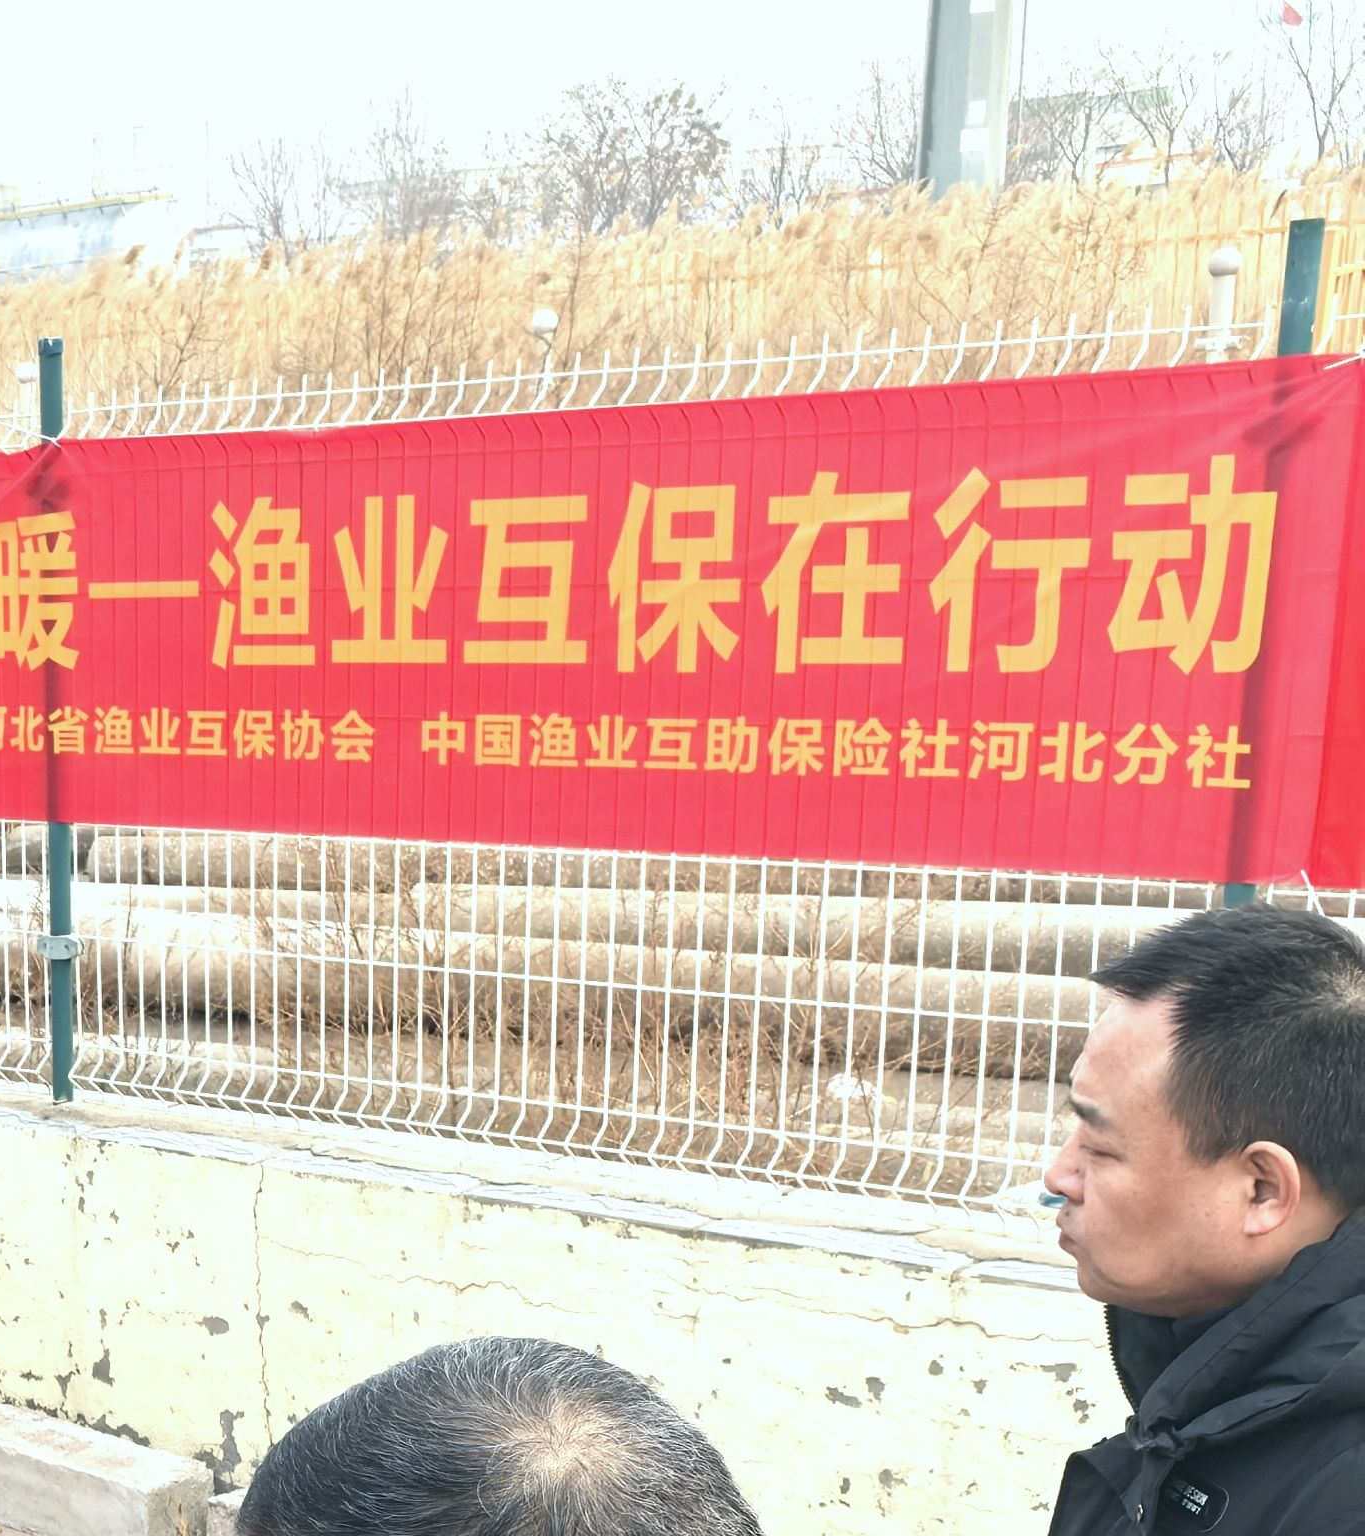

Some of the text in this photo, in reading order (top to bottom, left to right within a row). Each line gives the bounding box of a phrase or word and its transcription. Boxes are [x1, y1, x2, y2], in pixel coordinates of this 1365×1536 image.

[421, 711, 1252, 790] 中国渔业互助保险社河北分社
